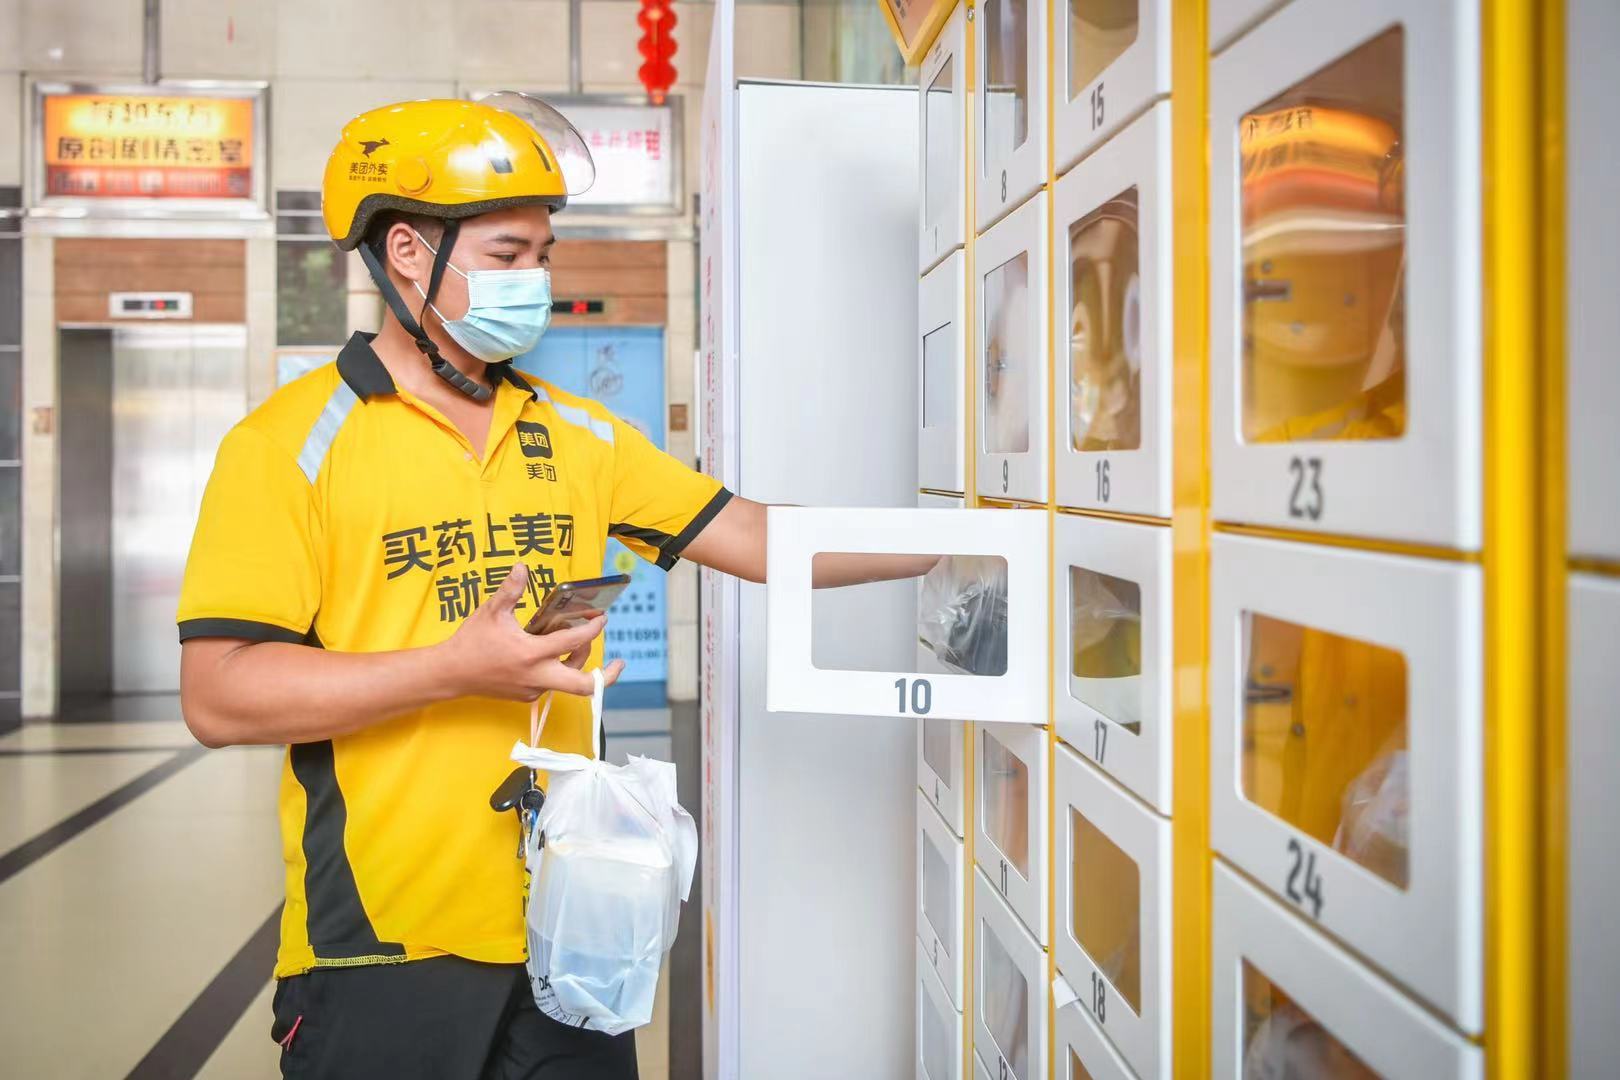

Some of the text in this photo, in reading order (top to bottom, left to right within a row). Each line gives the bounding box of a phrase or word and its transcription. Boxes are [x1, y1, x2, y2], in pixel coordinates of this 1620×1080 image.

[1090, 82, 1105, 131] 15
[349, 162, 388, 176] 美团外卖
[1001, 169, 1007, 203] 8
[519, 431, 550, 449] 美团
[526, 462, 557, 482] 美团
[1002, 459, 1009, 494] 9
[1096, 459, 1110, 503] 16
[1288, 456, 1324, 521] 23
[381, 512, 574, 581] 买药上美团
[894, 677, 932, 715] 10
[1094, 718, 1108, 764] 17
[1000, 859, 1008, 897] 11
[1286, 838, 1323, 918] 24
[1092, 971, 1106, 1024] 18
